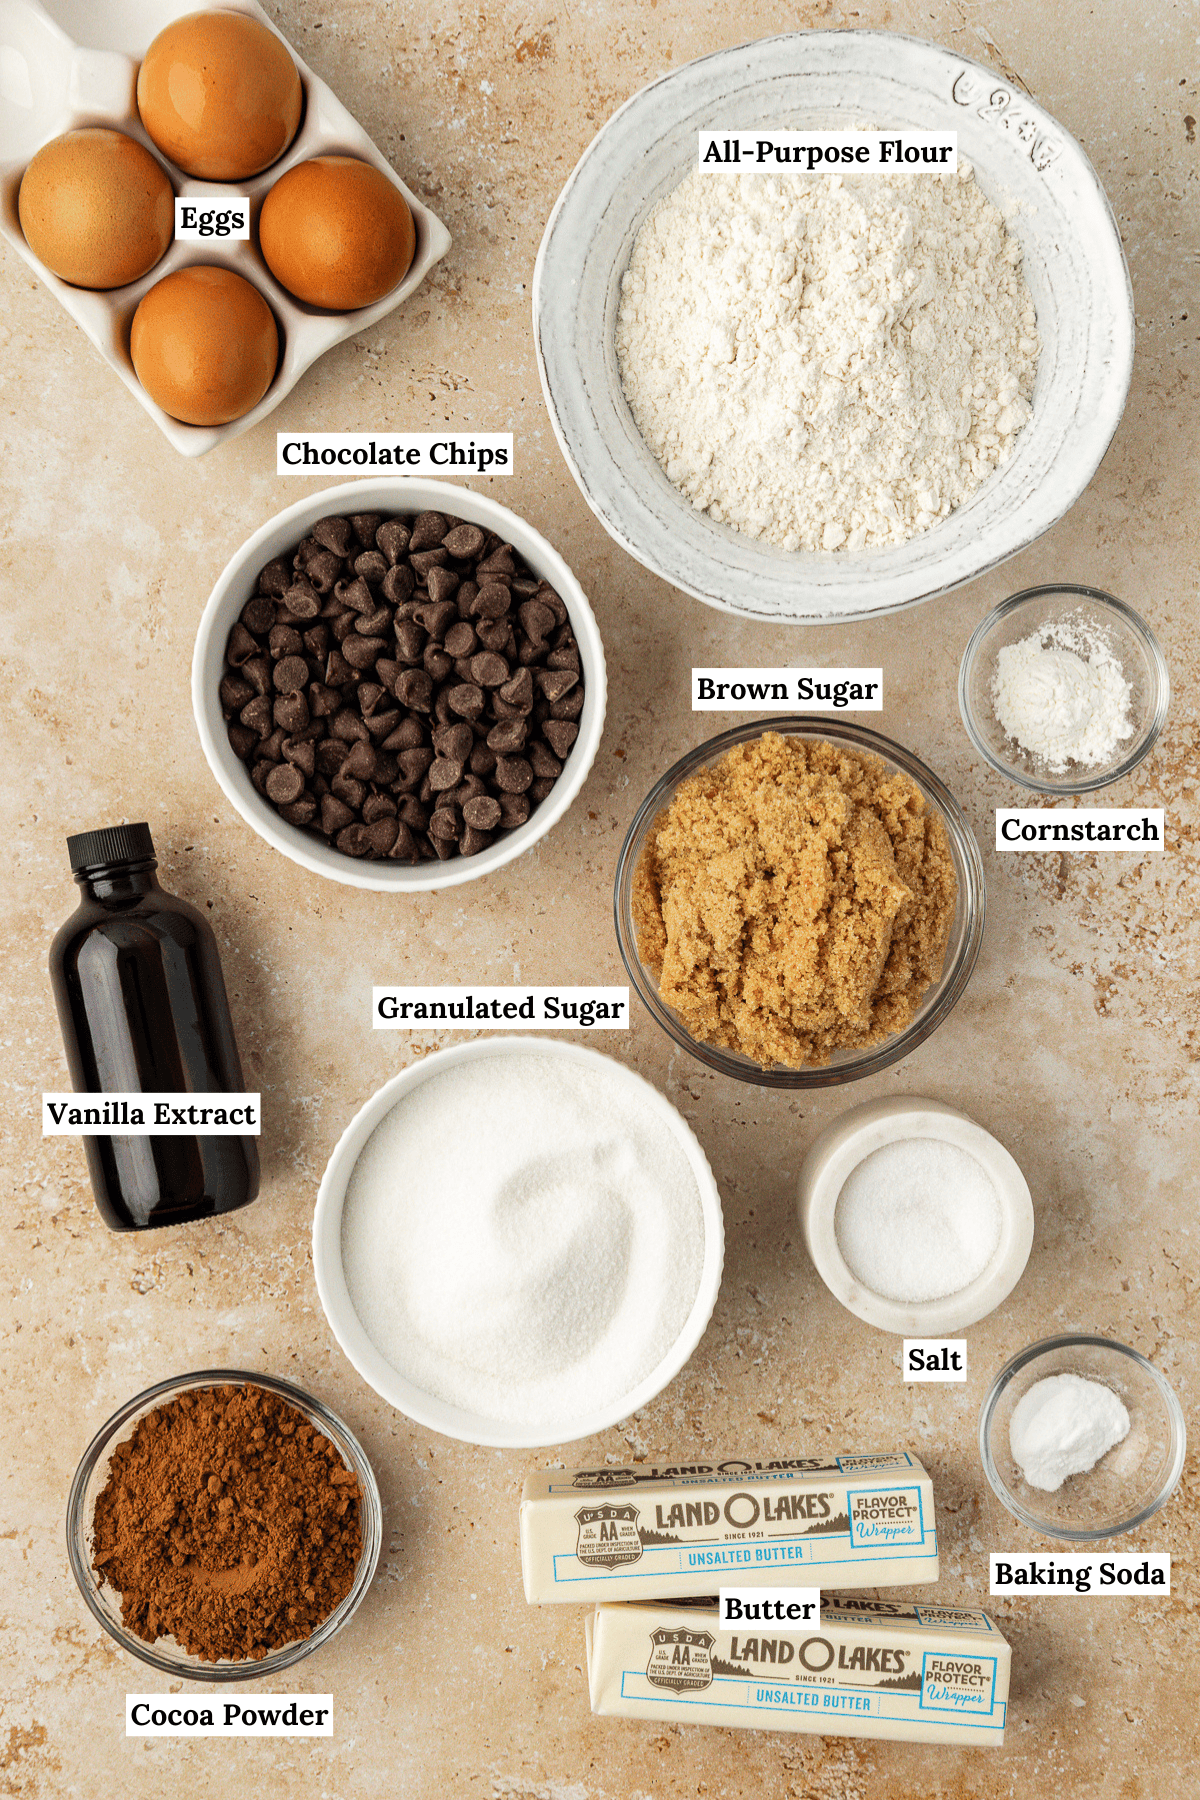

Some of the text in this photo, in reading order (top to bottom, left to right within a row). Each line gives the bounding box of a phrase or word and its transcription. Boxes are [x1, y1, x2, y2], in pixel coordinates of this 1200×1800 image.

[651, 1466, 713, 1476] LAND
[655, 1502, 720, 1529] LAND
[724, 1492, 760, 1529] O
[856, 1496, 908, 1509] FLAVOR
[600, 1521, 618, 1542] AA
[724, 1532, 747, 1540] SINCE
[856, 1522, 915, 1540] Wrapper
[688, 1546, 803, 1566] UNSALTED BUTTER
[672, 1645, 690, 1665] AA
[730, 1636, 795, 1664] LAND
[798, 1636, 835, 1672] O
[932, 1660, 982, 1674] FLAVOR
[795, 1675, 835, 1684] SINCE 1921
[756, 1688, 871, 1711] UNSALTED BUTTER
[927, 1684, 985, 1706] Wrapper
